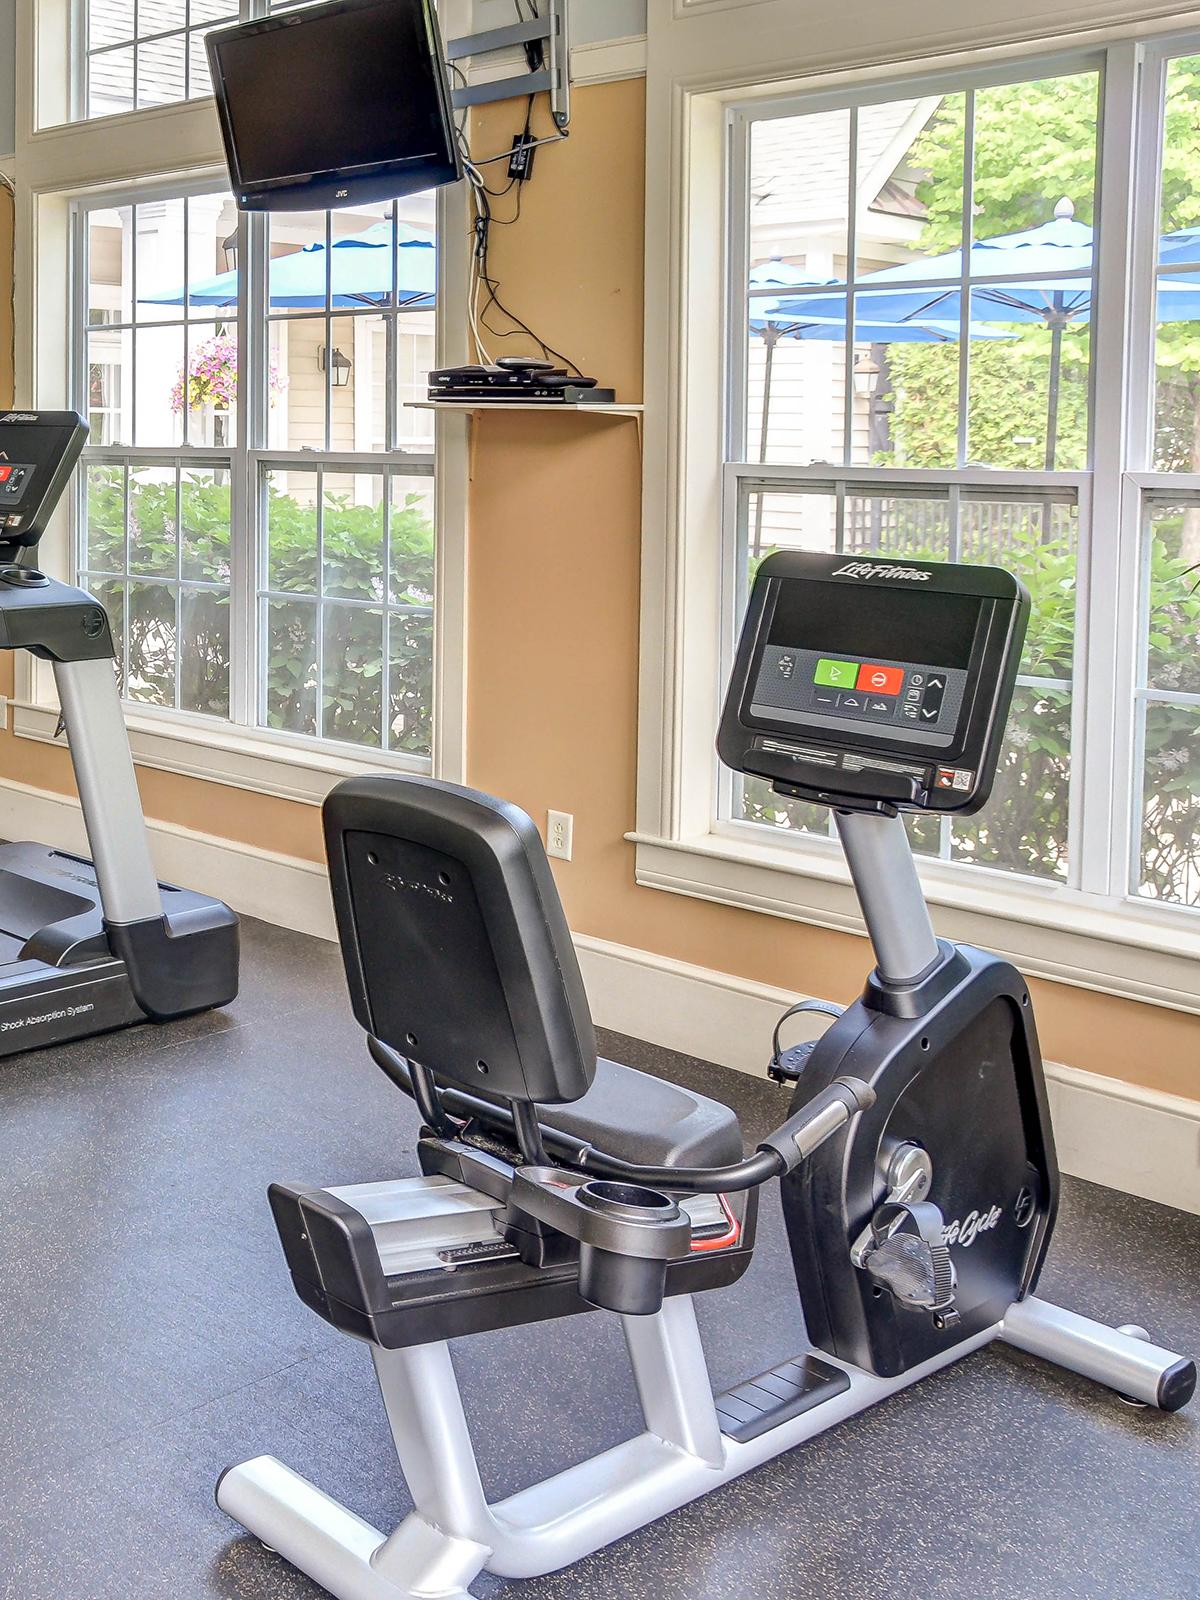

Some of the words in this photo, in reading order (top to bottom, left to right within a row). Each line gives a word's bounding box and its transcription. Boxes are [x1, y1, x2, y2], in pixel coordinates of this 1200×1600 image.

[335, 189, 348, 198] JVC
[1, 1018, 25, 1032] Shock
[25, 1009, 67, 1026] Absorption
[67, 1003, 95, 1017] System
